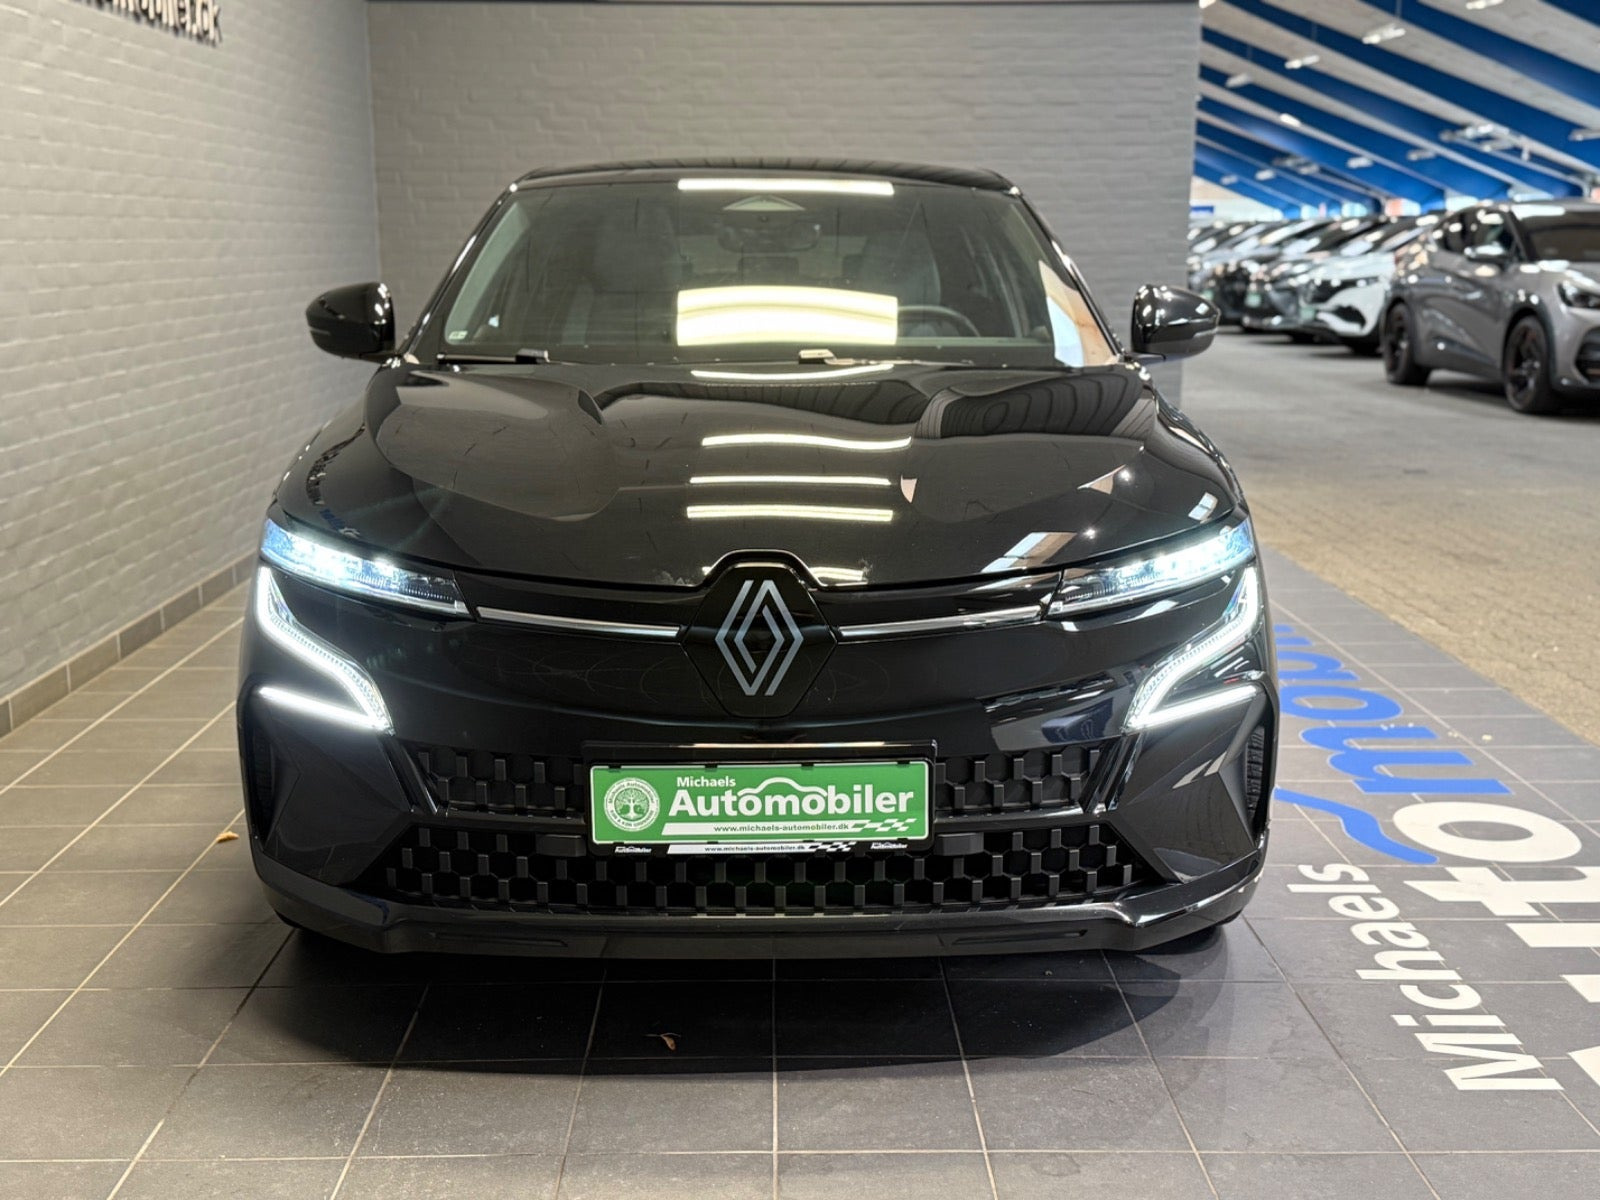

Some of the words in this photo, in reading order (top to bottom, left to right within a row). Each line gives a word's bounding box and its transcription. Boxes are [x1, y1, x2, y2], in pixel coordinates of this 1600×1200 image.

[677, 776, 736, 787] Michaels
[668, 784, 914, 817] Automobiler
[714, 822, 849, 832] www.michaels-automobiler.dk
[1286, 863, 1565, 1091] Michaels
